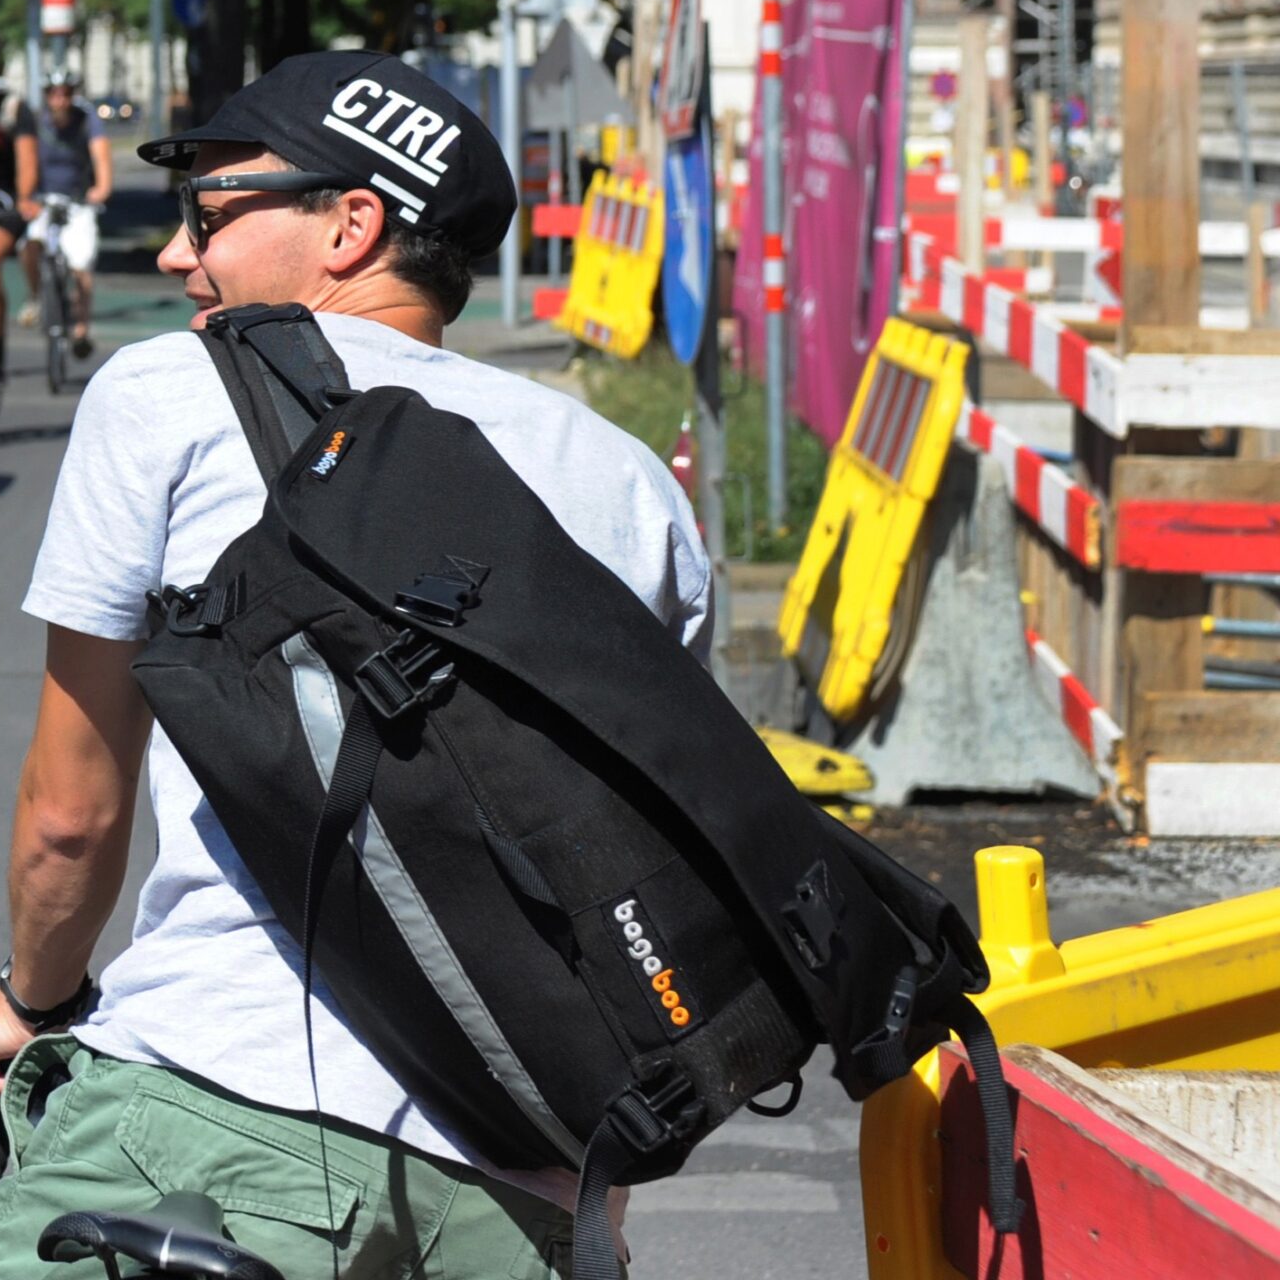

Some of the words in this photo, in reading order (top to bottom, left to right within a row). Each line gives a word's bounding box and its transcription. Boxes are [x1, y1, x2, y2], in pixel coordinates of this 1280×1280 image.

[332, 78, 462, 174] CTRL
[311, 431, 346, 475] bagaboo
[614, 899, 690, 1026] bagaboo
